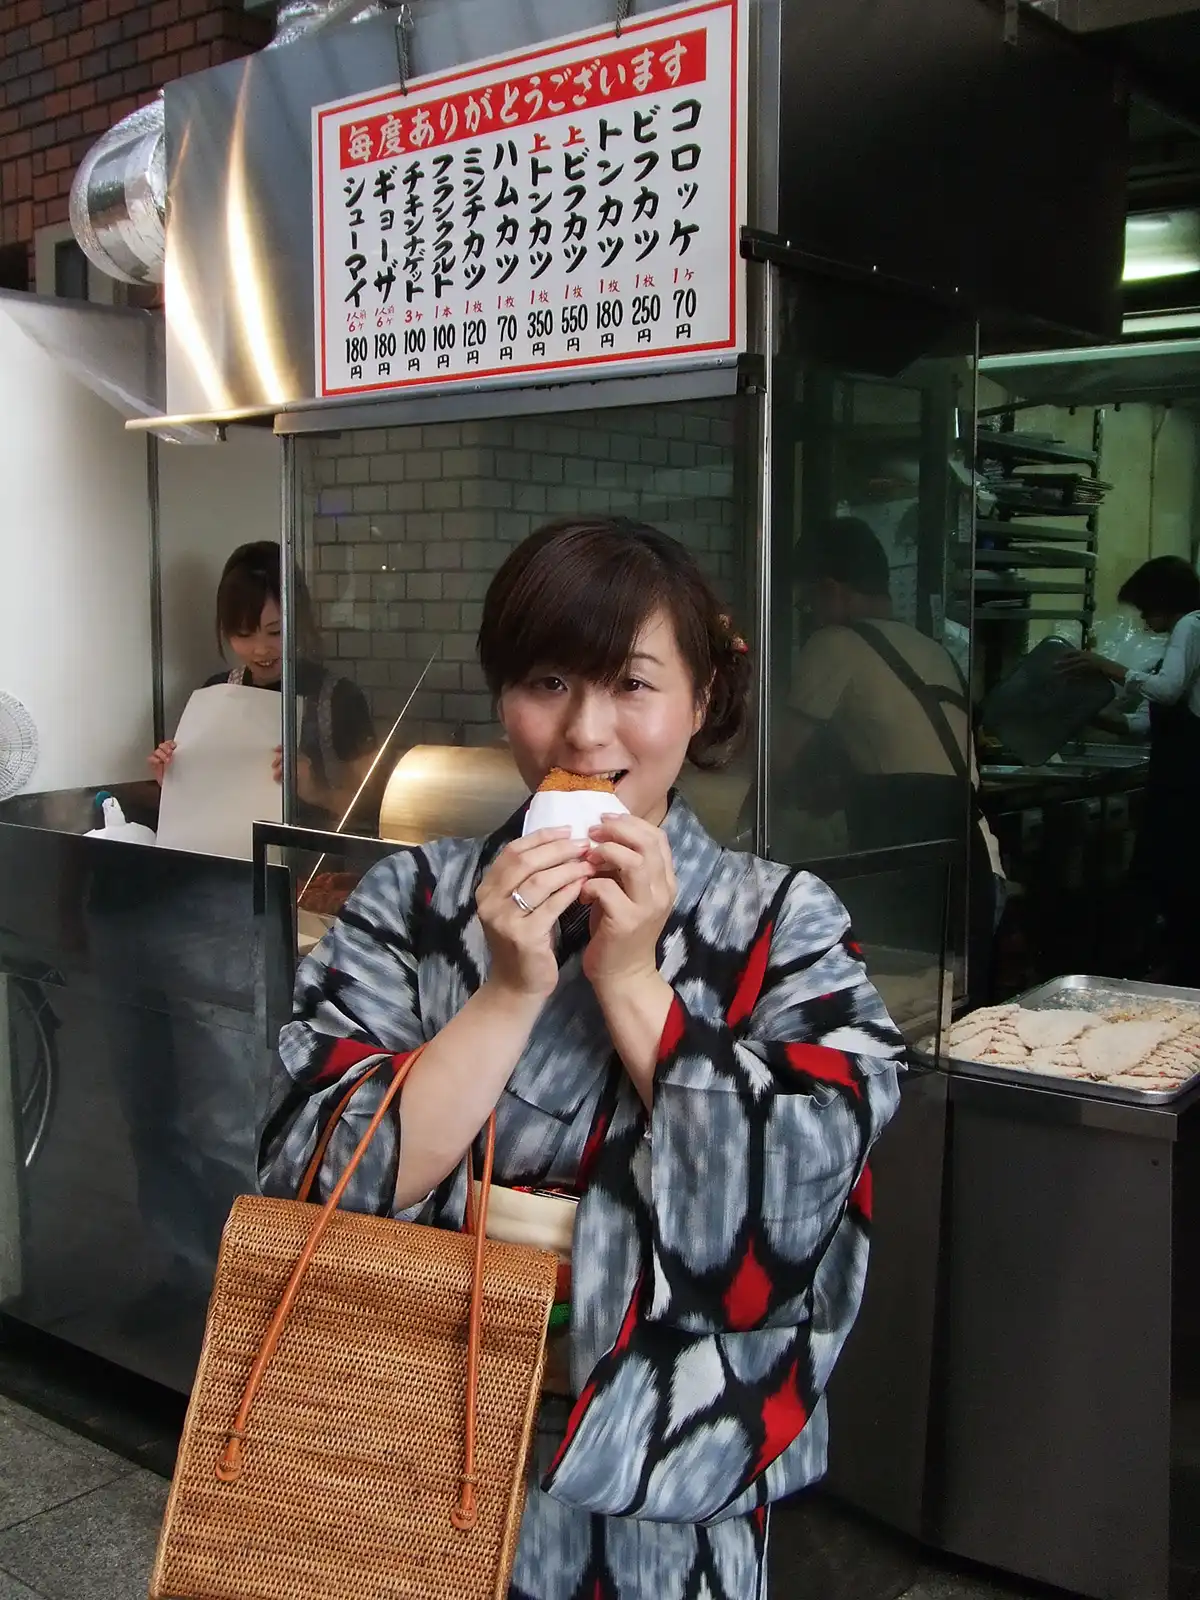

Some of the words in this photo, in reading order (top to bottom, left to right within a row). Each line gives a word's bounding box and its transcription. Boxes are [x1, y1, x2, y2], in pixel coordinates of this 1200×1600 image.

[347, 40, 688, 163] 毎度ありがとうございます
[632, 105, 660, 262] ビフカツ
[670, 99, 701, 256] コロッケ
[597, 119, 624, 268] トンカツ
[462, 148, 486, 290] ミンチカツ
[493, 140, 519, 284] ハムカツ
[373, 166, 398, 303] ギョーザ
[403, 161, 425, 303] チキンナゲット
[431, 155, 455, 298] フランクフルト
[344, 178, 367, 307] シューマイ
[565, 284, 583, 299] 1枚
[600, 279, 620, 293] 1枚
[635, 274, 656, 288] 1枚
[466, 300, 483, 314] 1枚
[498, 295, 515, 309] 1枚
[530, 290, 549, 304] 1枚
[632, 295, 660, 325] 250
[673, 288, 696, 318] 70
[435, 305, 453, 318] 1本
[527, 310, 553, 338] 350
[562, 304, 587, 334] 550
[597, 300, 623, 329] 180
[404, 328, 425, 354] 100
[434, 324, 455, 351] 100
[463, 319, 486, 347] 120
[498, 315, 517, 342] 70
[346, 337, 367, 363] 180
[375, 333, 396, 359] 180
